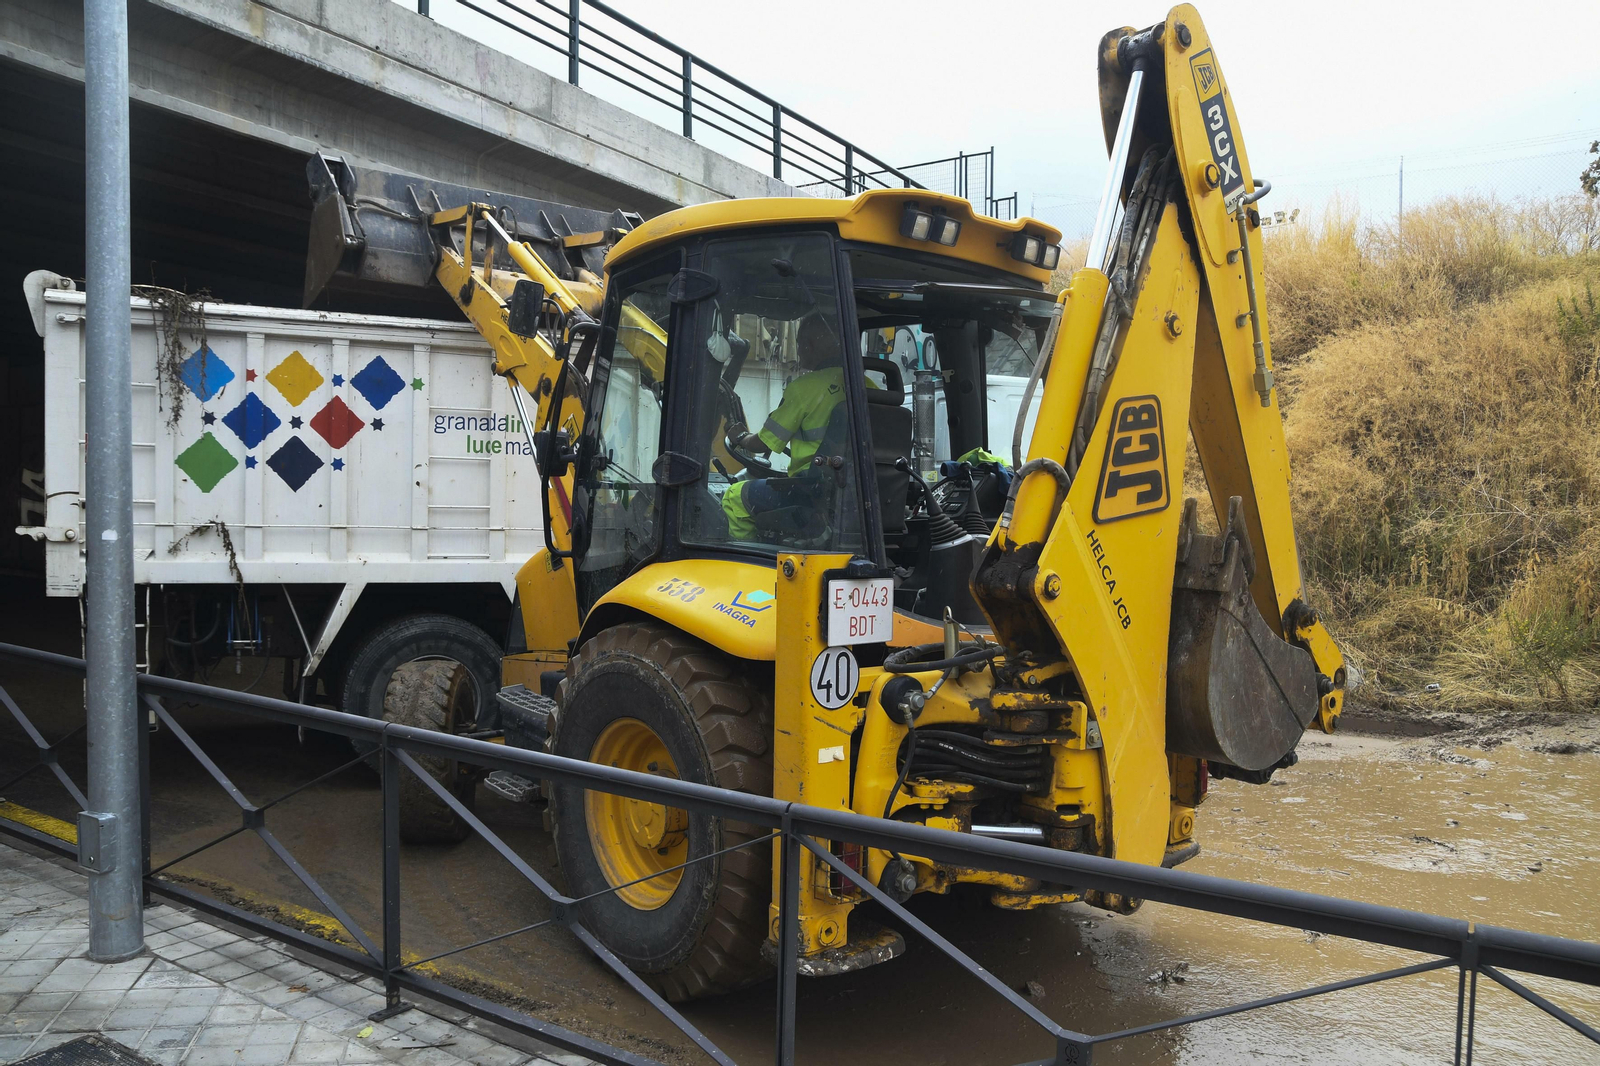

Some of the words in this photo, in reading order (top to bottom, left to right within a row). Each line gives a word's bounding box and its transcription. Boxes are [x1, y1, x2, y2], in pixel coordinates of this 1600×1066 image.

[1197, 66, 1215, 90] JCB
[1207, 104, 1239, 185] 3CX
[466, 434, 502, 454] luce
[1104, 403, 1163, 505] JCB
[656, 577, 706, 603] 558
[1086, 529, 1117, 595] HELCA
[1112, 597, 1132, 630] JCB
[835, 588, 844, 609] E
[852, 586, 889, 608] 0443
[712, 602, 758, 628] INAGRA
[849, 615, 877, 637] BDT
[816, 651, 850, 703] 40
